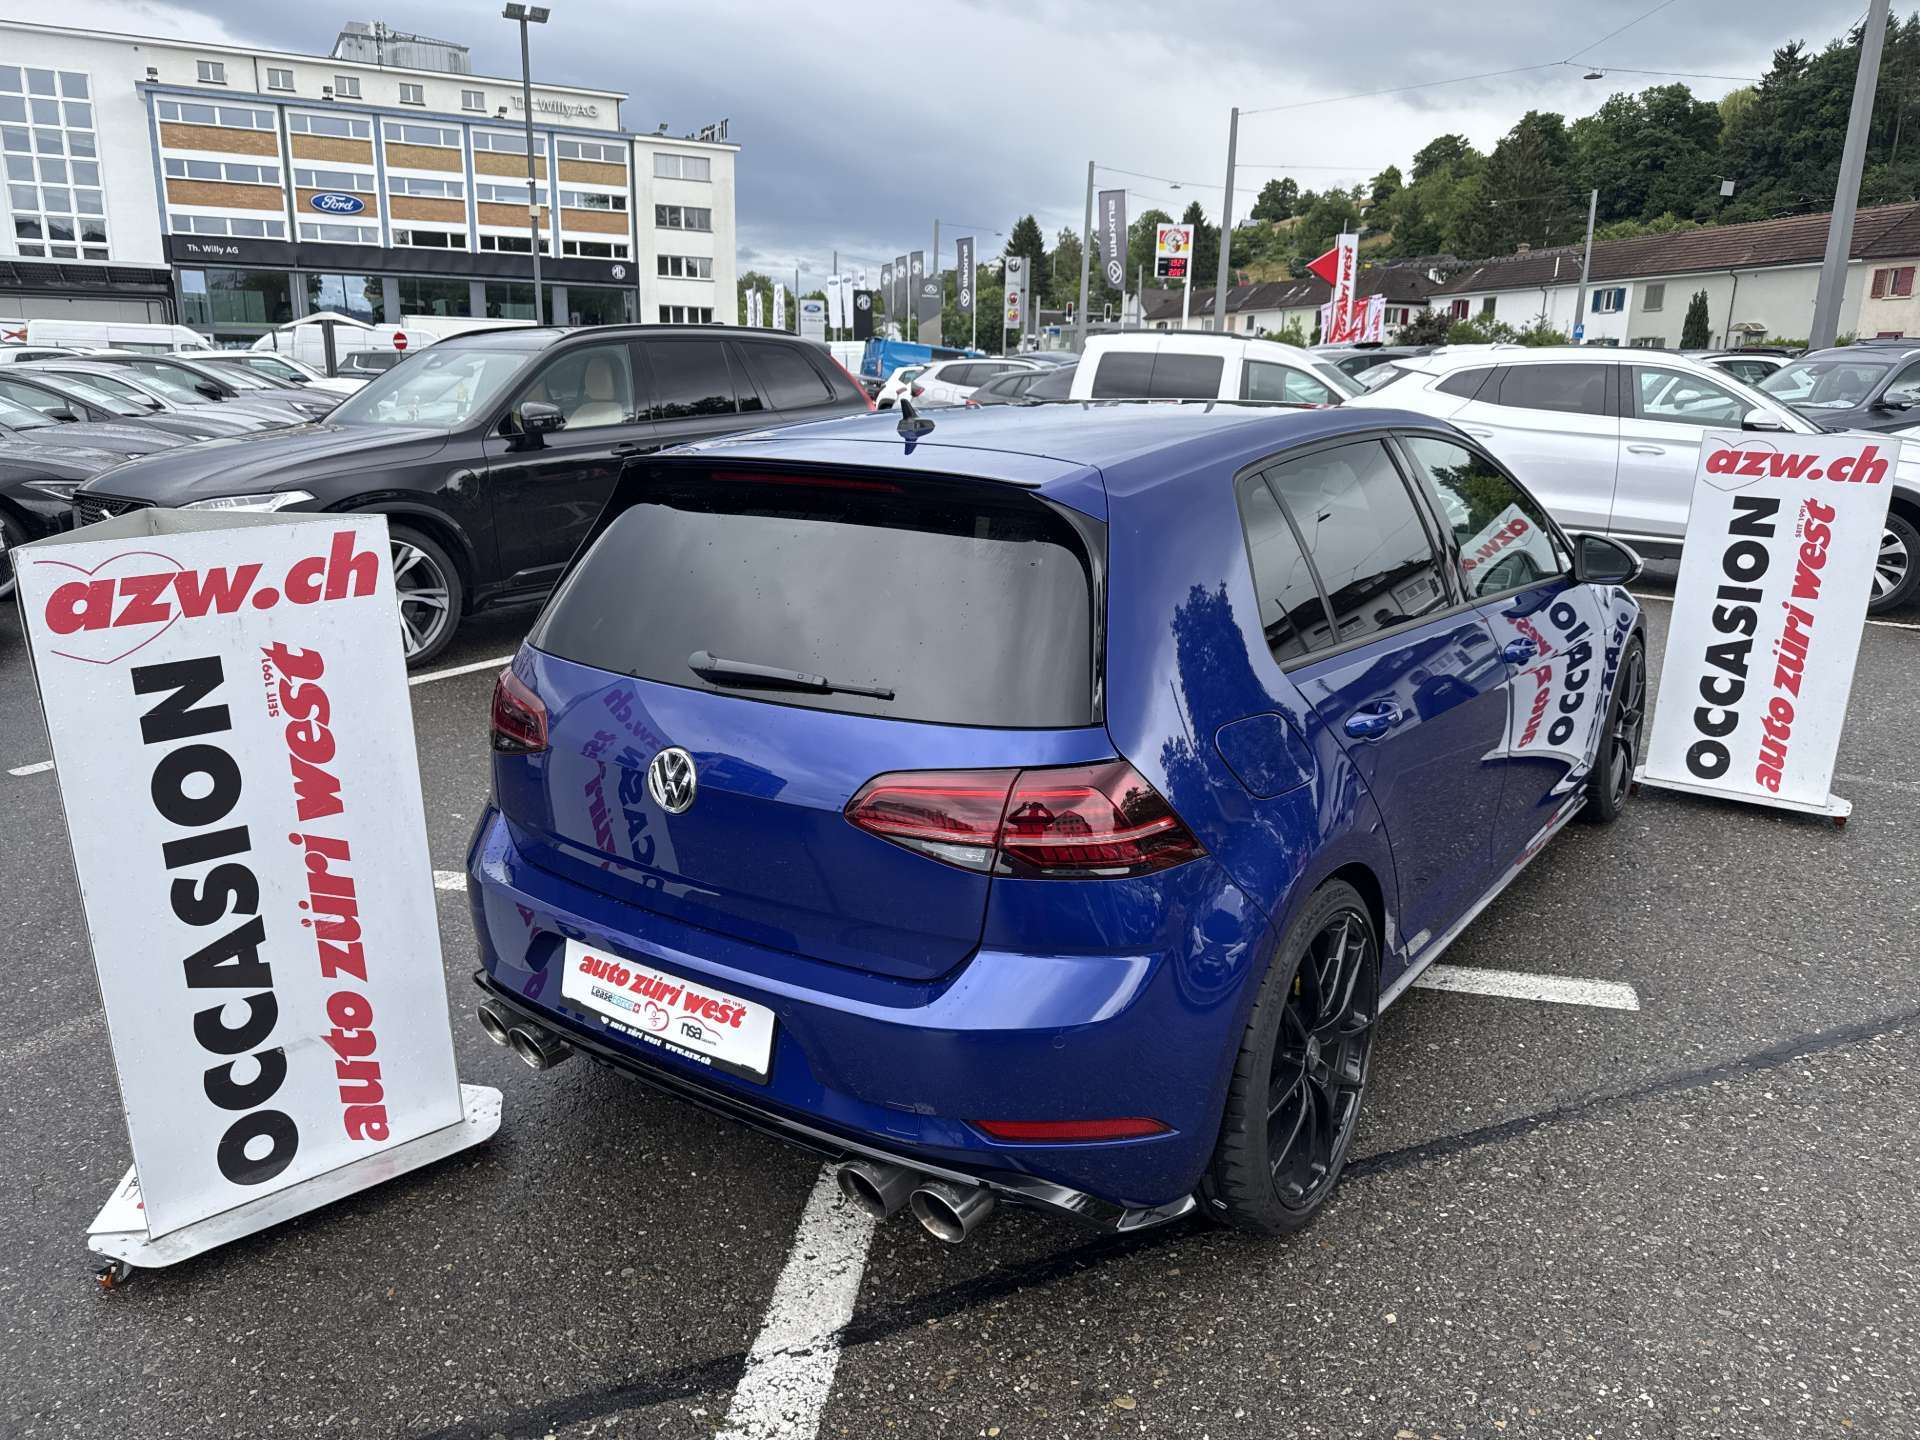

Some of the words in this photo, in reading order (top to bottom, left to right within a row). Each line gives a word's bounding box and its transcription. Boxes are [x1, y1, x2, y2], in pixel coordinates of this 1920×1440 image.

[537, 97, 573, 117] Willy
[576, 103, 599, 119] AG
[187, 244, 201, 252] Th.
[202, 245, 224, 256] Willy
[226, 246, 239, 254] AG
[1108, 200, 1118, 257] MAXUS
[1343, 245, 1353, 281] west
[1706, 445, 1889, 484] azw.ch
[45, 531, 379, 634] azw.ch
[1791, 498, 1836, 600] west
[261, 658, 274, 687] 1991
[1686, 496, 1780, 779] OCCASION
[1772, 601, 1815, 698] züri
[259, 641, 345, 822] west
[267, 692, 279, 718] SEIT
[1755, 697, 1795, 793] auto
[131, 656, 299, 1186] OCCASION
[289, 833, 368, 983] züri
[579, 955, 630, 987] auto
[629, 974, 685, 1006] züri
[683, 991, 747, 1029] west
[320, 990, 389, 1142] auto
[610, 1020, 627, 1033] auto
[627, 1027, 643, 1040] züri
[644, 1034, 662, 1048] west
[665, 1042, 712, 1066] www.azw.ch
[681, 1022, 703, 1040] nsa
